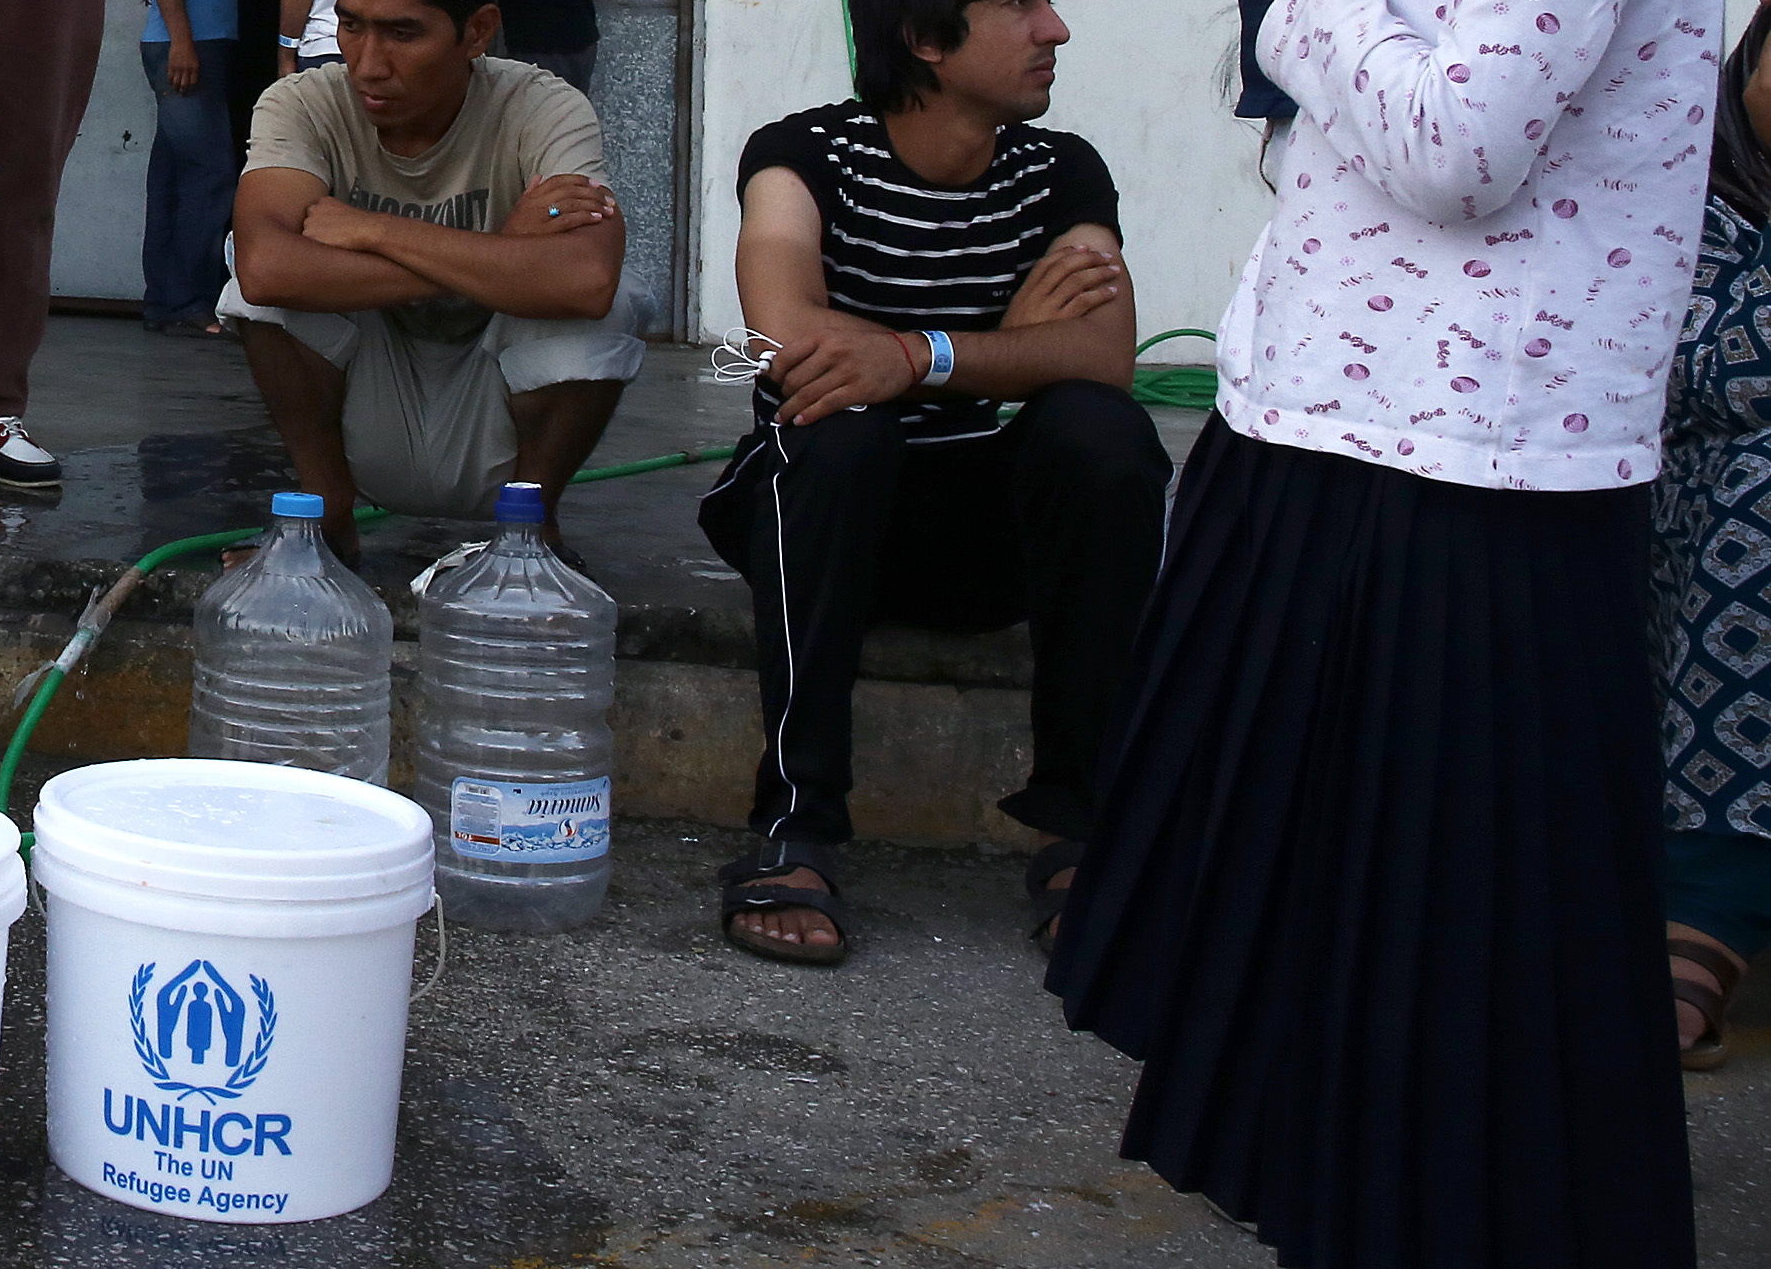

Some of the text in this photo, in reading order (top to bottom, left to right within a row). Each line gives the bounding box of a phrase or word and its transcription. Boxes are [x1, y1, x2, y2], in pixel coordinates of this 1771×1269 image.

[529, 793, 602, 819] Samaria
[103, 1087, 293, 1158] UNHCR
[154, 1150, 234, 1182] The UN
[103, 1162, 289, 1216] Refugee Agency
